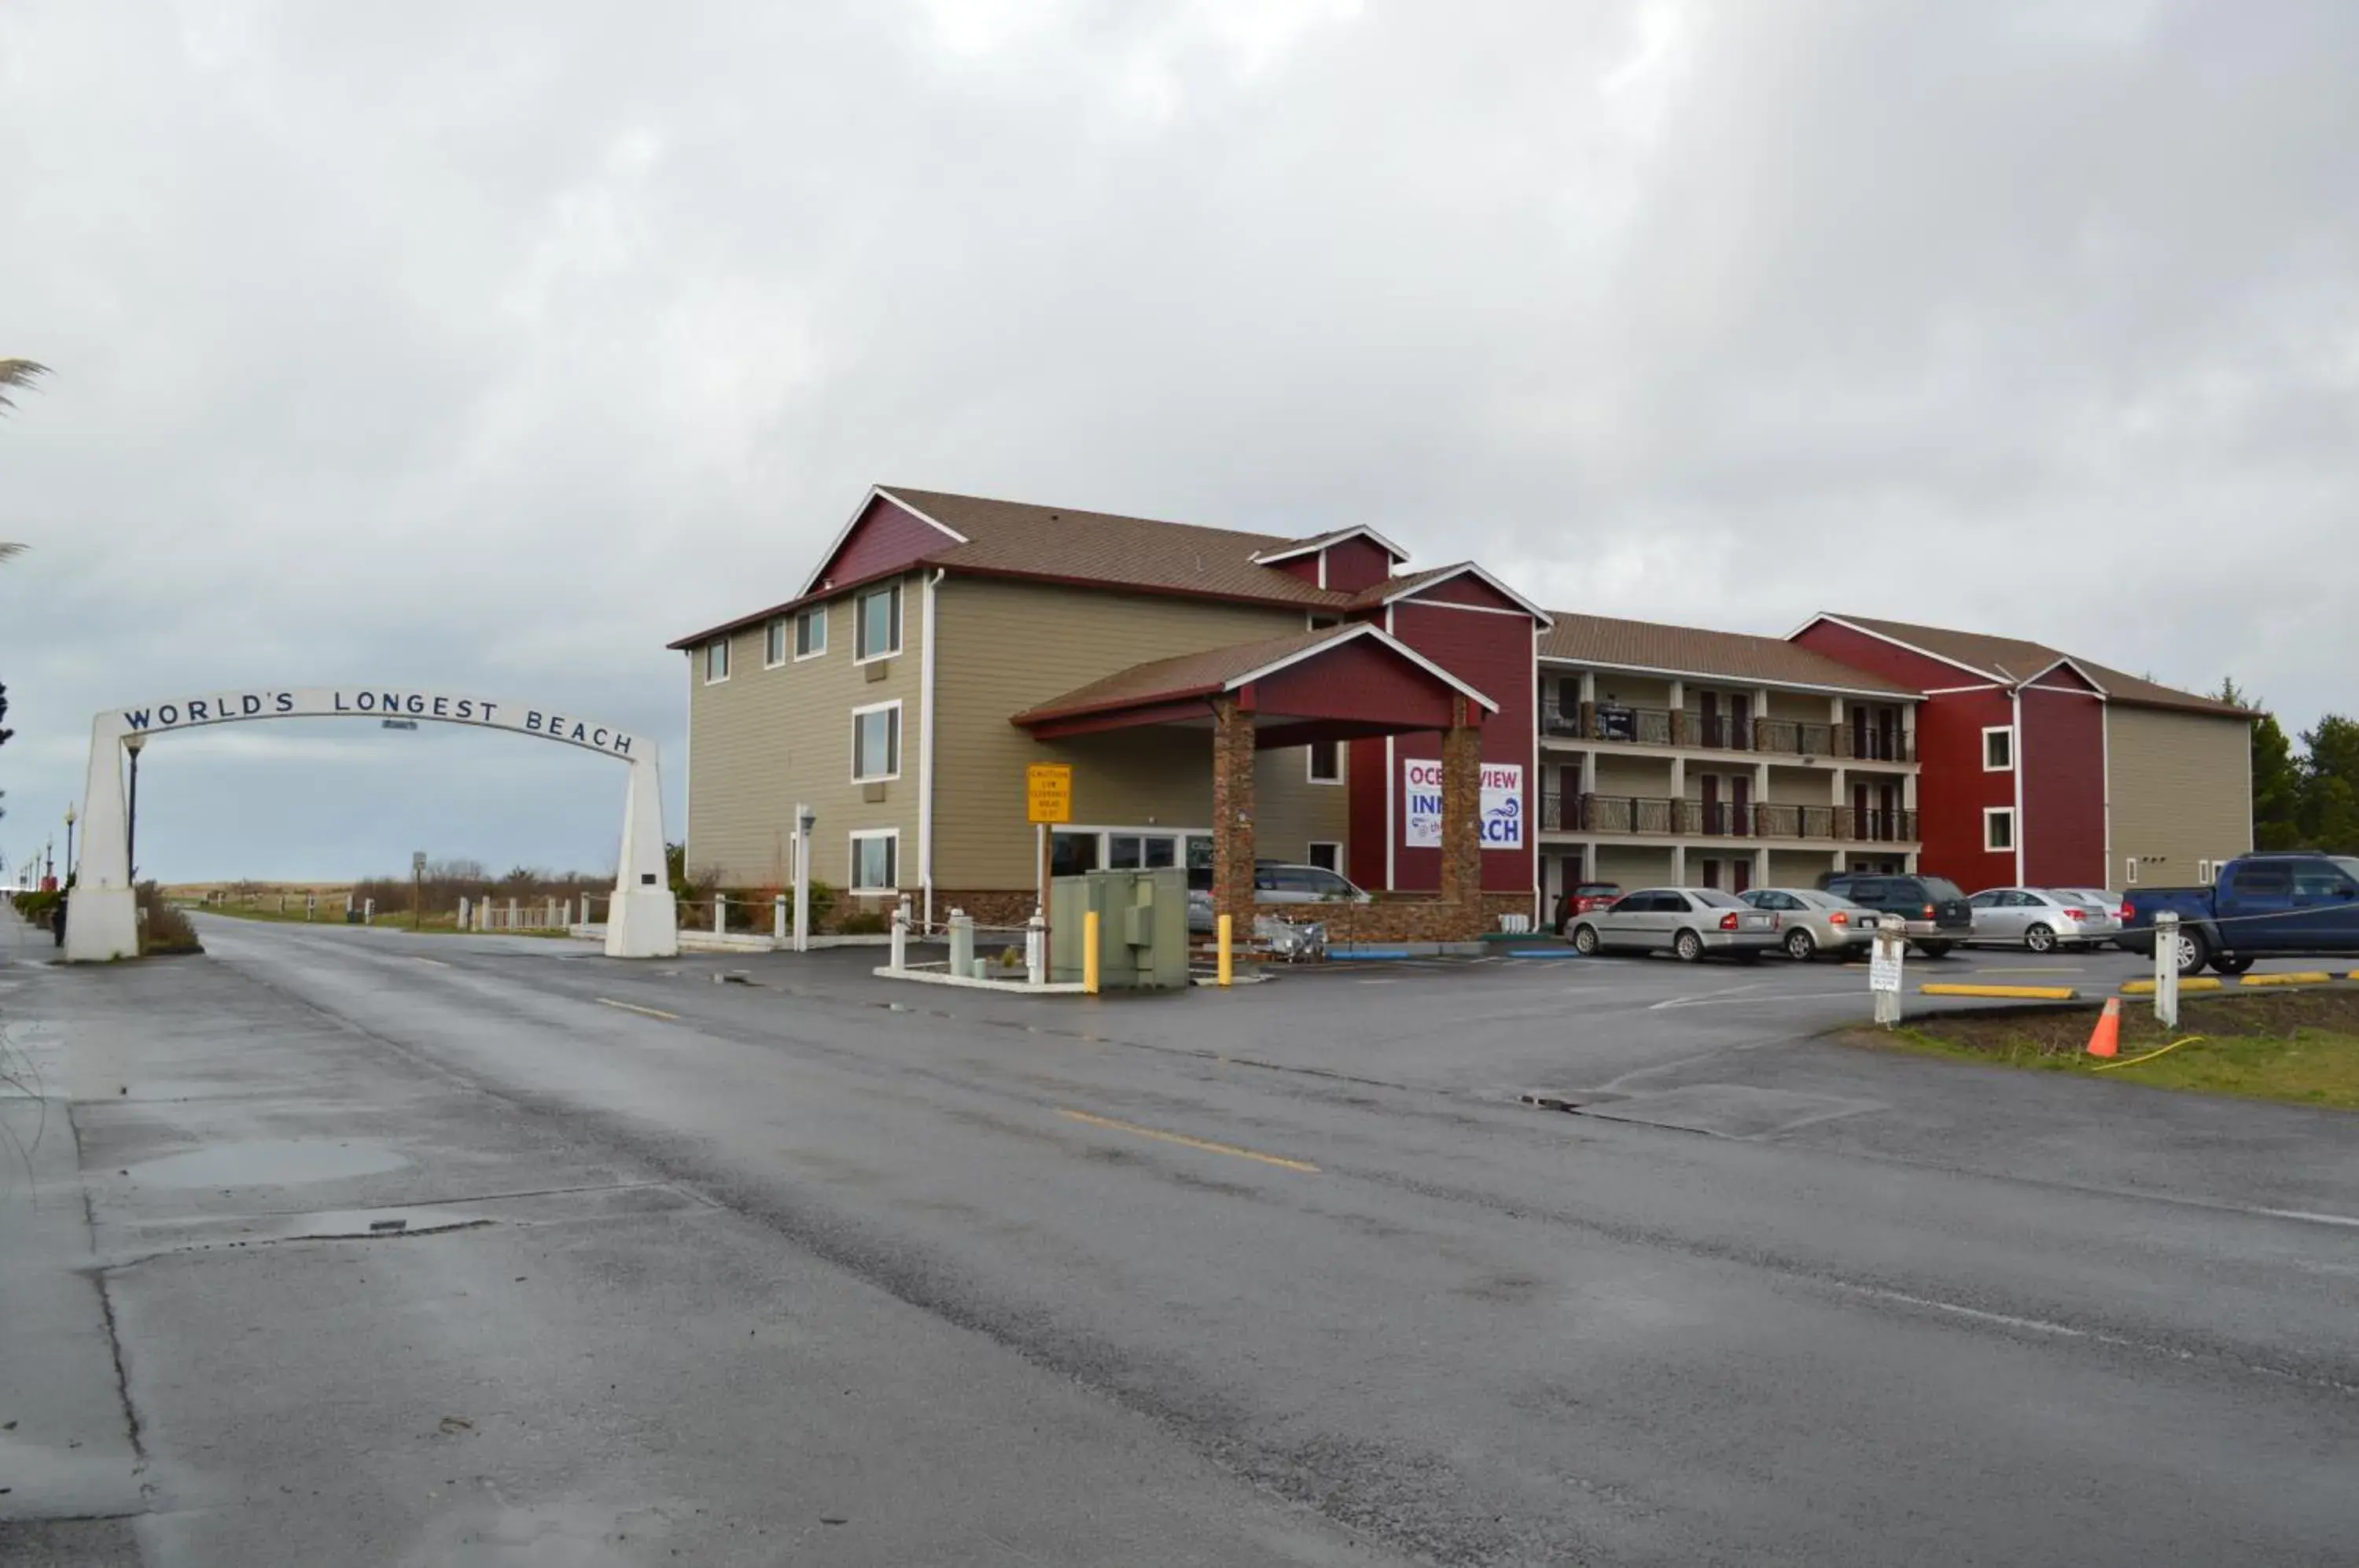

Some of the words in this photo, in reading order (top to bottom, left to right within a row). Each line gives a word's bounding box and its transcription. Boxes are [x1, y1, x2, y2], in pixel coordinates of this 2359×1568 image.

[124, 692, 293, 730] WORLD'S
[334, 691, 497, 721] LONGEST
[525, 710, 632, 754] BEACH
[1410, 767, 1442, 785] OCE
[1479, 819, 1518, 841] RCH
